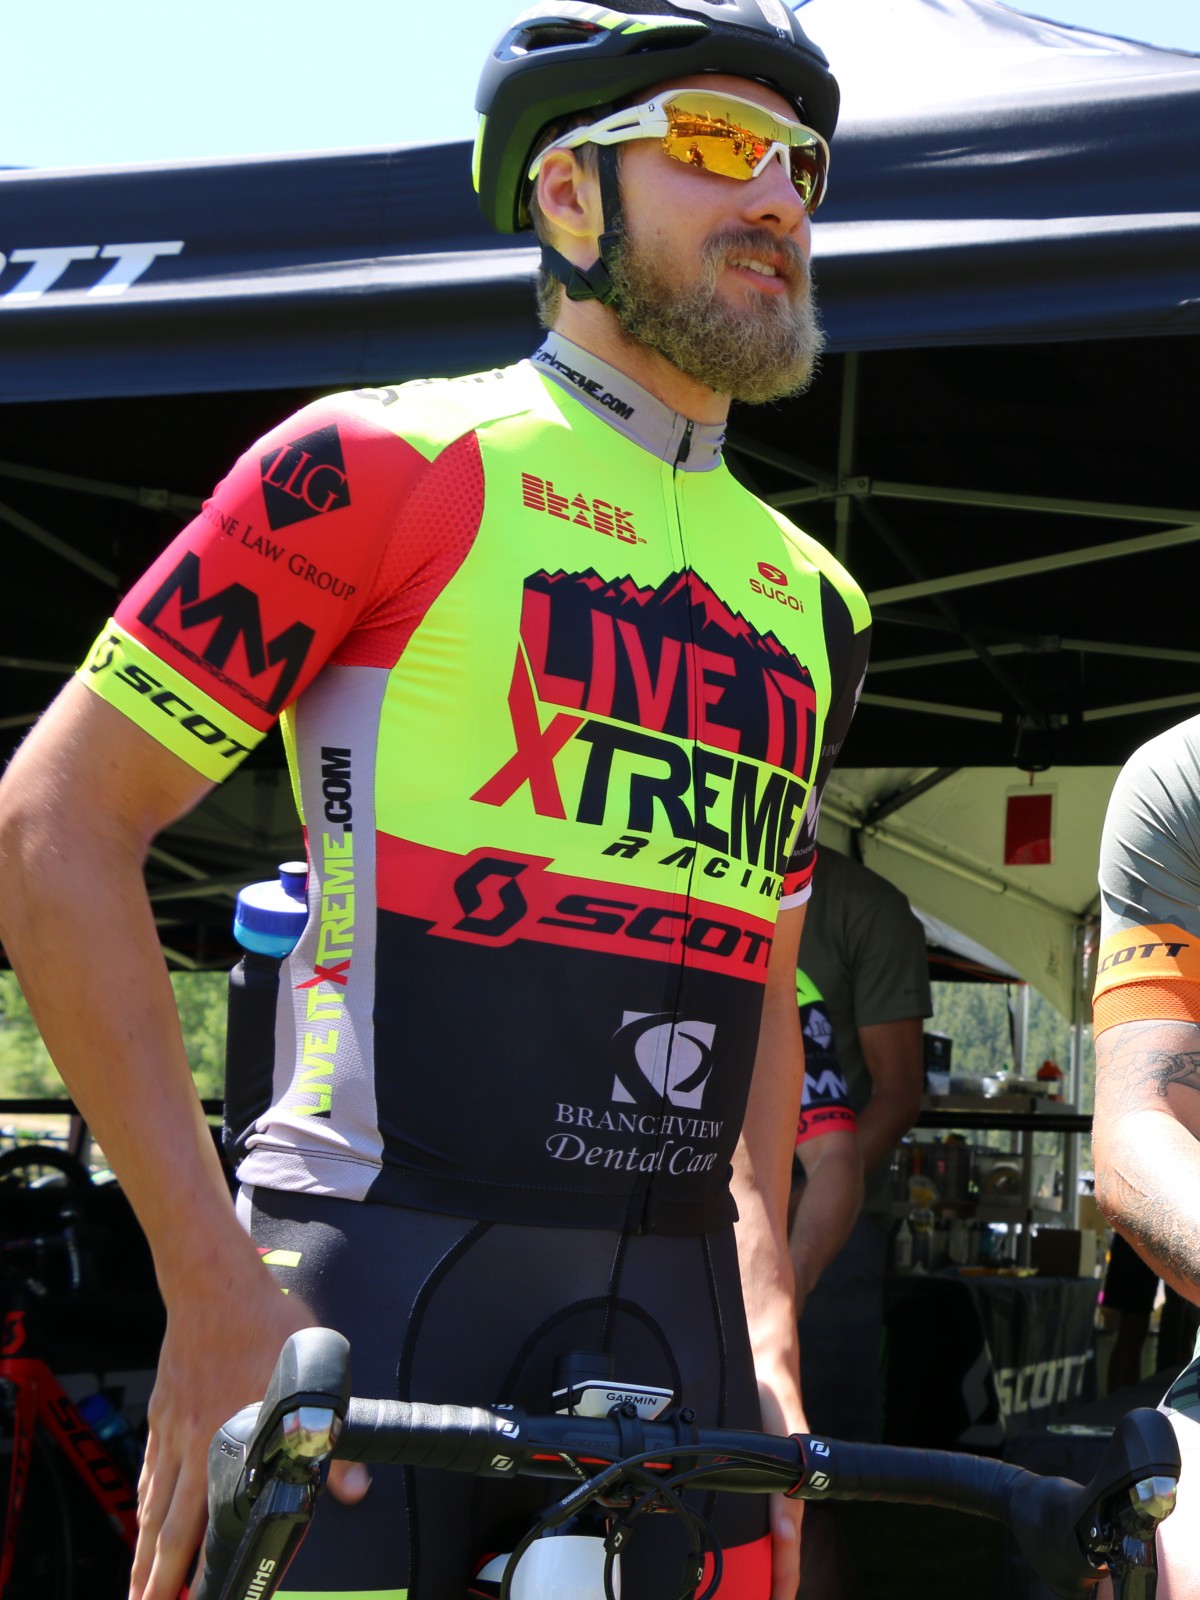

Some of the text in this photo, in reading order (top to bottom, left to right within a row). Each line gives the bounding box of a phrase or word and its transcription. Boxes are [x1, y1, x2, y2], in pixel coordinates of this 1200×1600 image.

[0, 241, 185, 302] TT
[240, 525, 286, 563] LAW
[288, 553, 357, 601] GROUP
[519, 588, 817, 784] LIVE IT
[469, 641, 809, 873] XTREME
[600, 835, 784, 901] RACING
[1096, 942, 1190, 976] COTT
[293, 1030, 338, 1118] LIVE
[555, 1102, 724, 1139] BRANCHVIEW
[545, 1132, 718, 1176] Dental Care
[606, 1391, 658, 1406] GARMIN
[994, 1350, 1095, 1417] SCOTT
